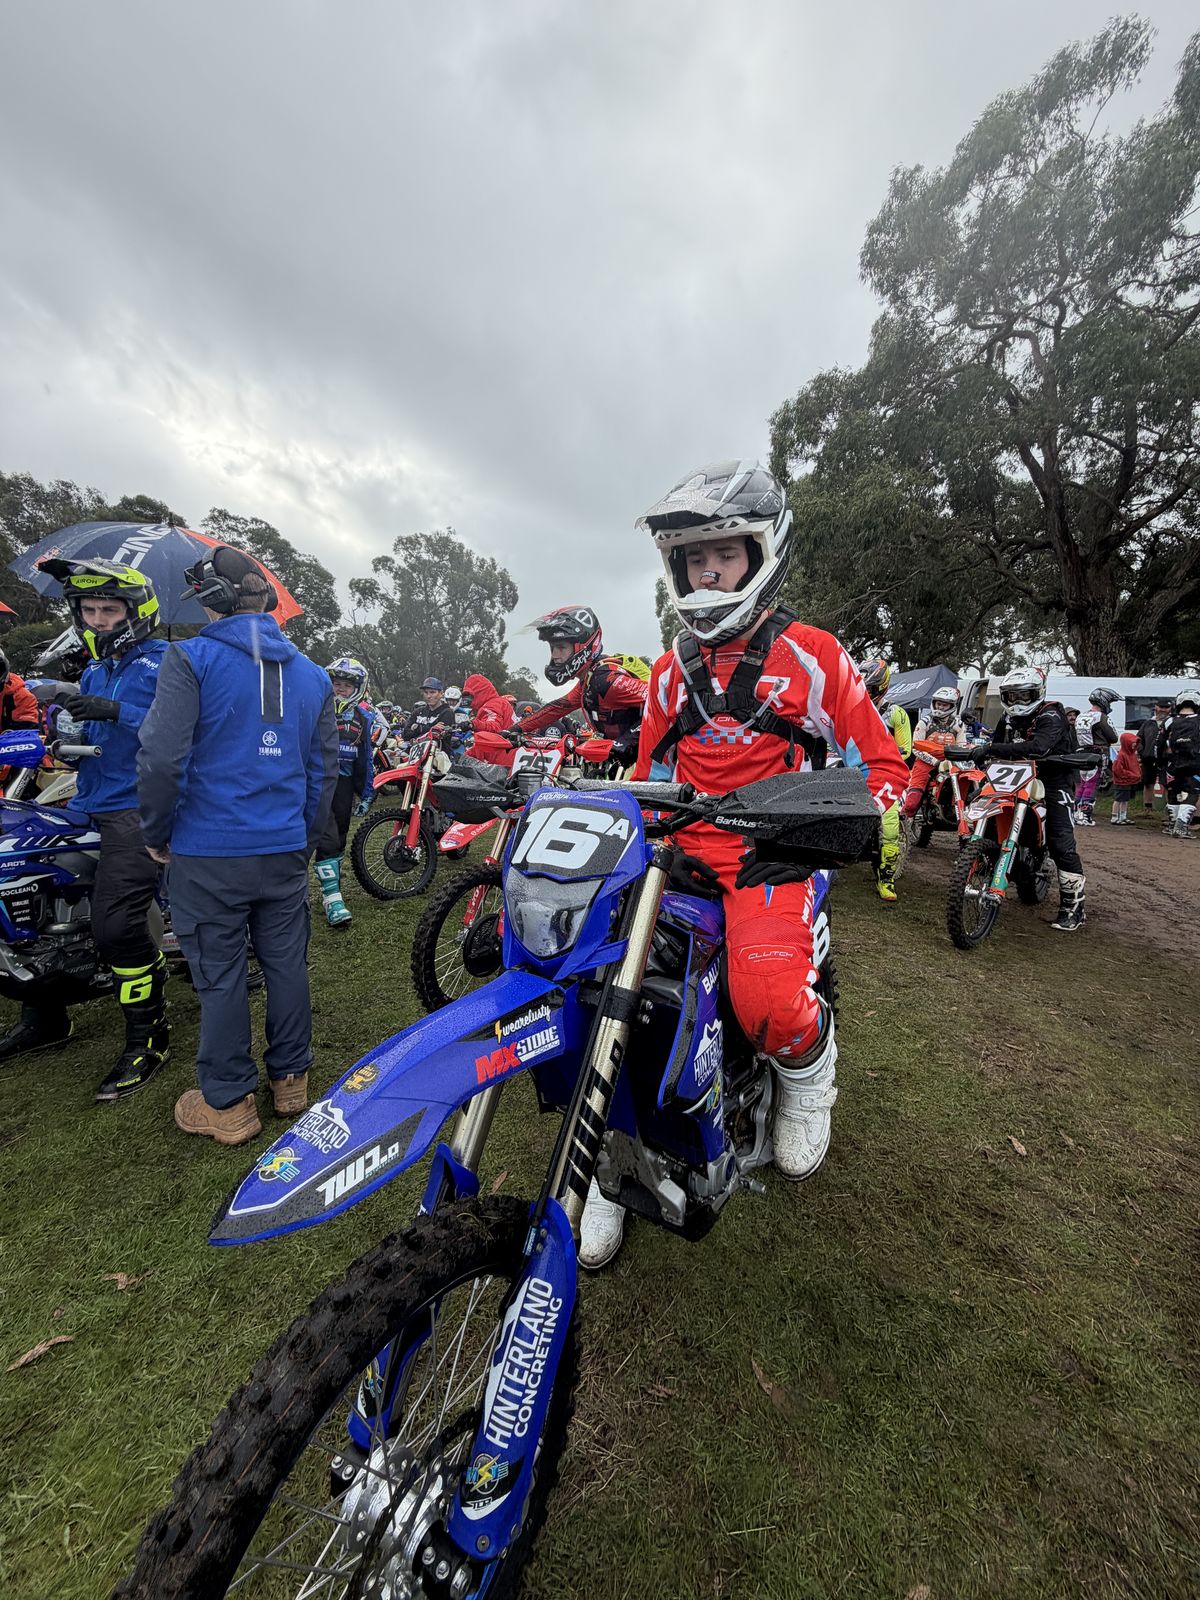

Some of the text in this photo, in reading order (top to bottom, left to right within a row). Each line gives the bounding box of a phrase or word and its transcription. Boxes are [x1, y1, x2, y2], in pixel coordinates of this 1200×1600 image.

[259, 747, 282, 755] YAMAHA
[991, 766, 1027, 786] 21
[119, 974, 153, 1004] G
[701, 956, 720, 995] BALL
[502, 1003, 552, 1037] wearelusty
[485, 1277, 553, 1450] HINTERLAND
[513, 1296, 563, 1438] CONCRETING
